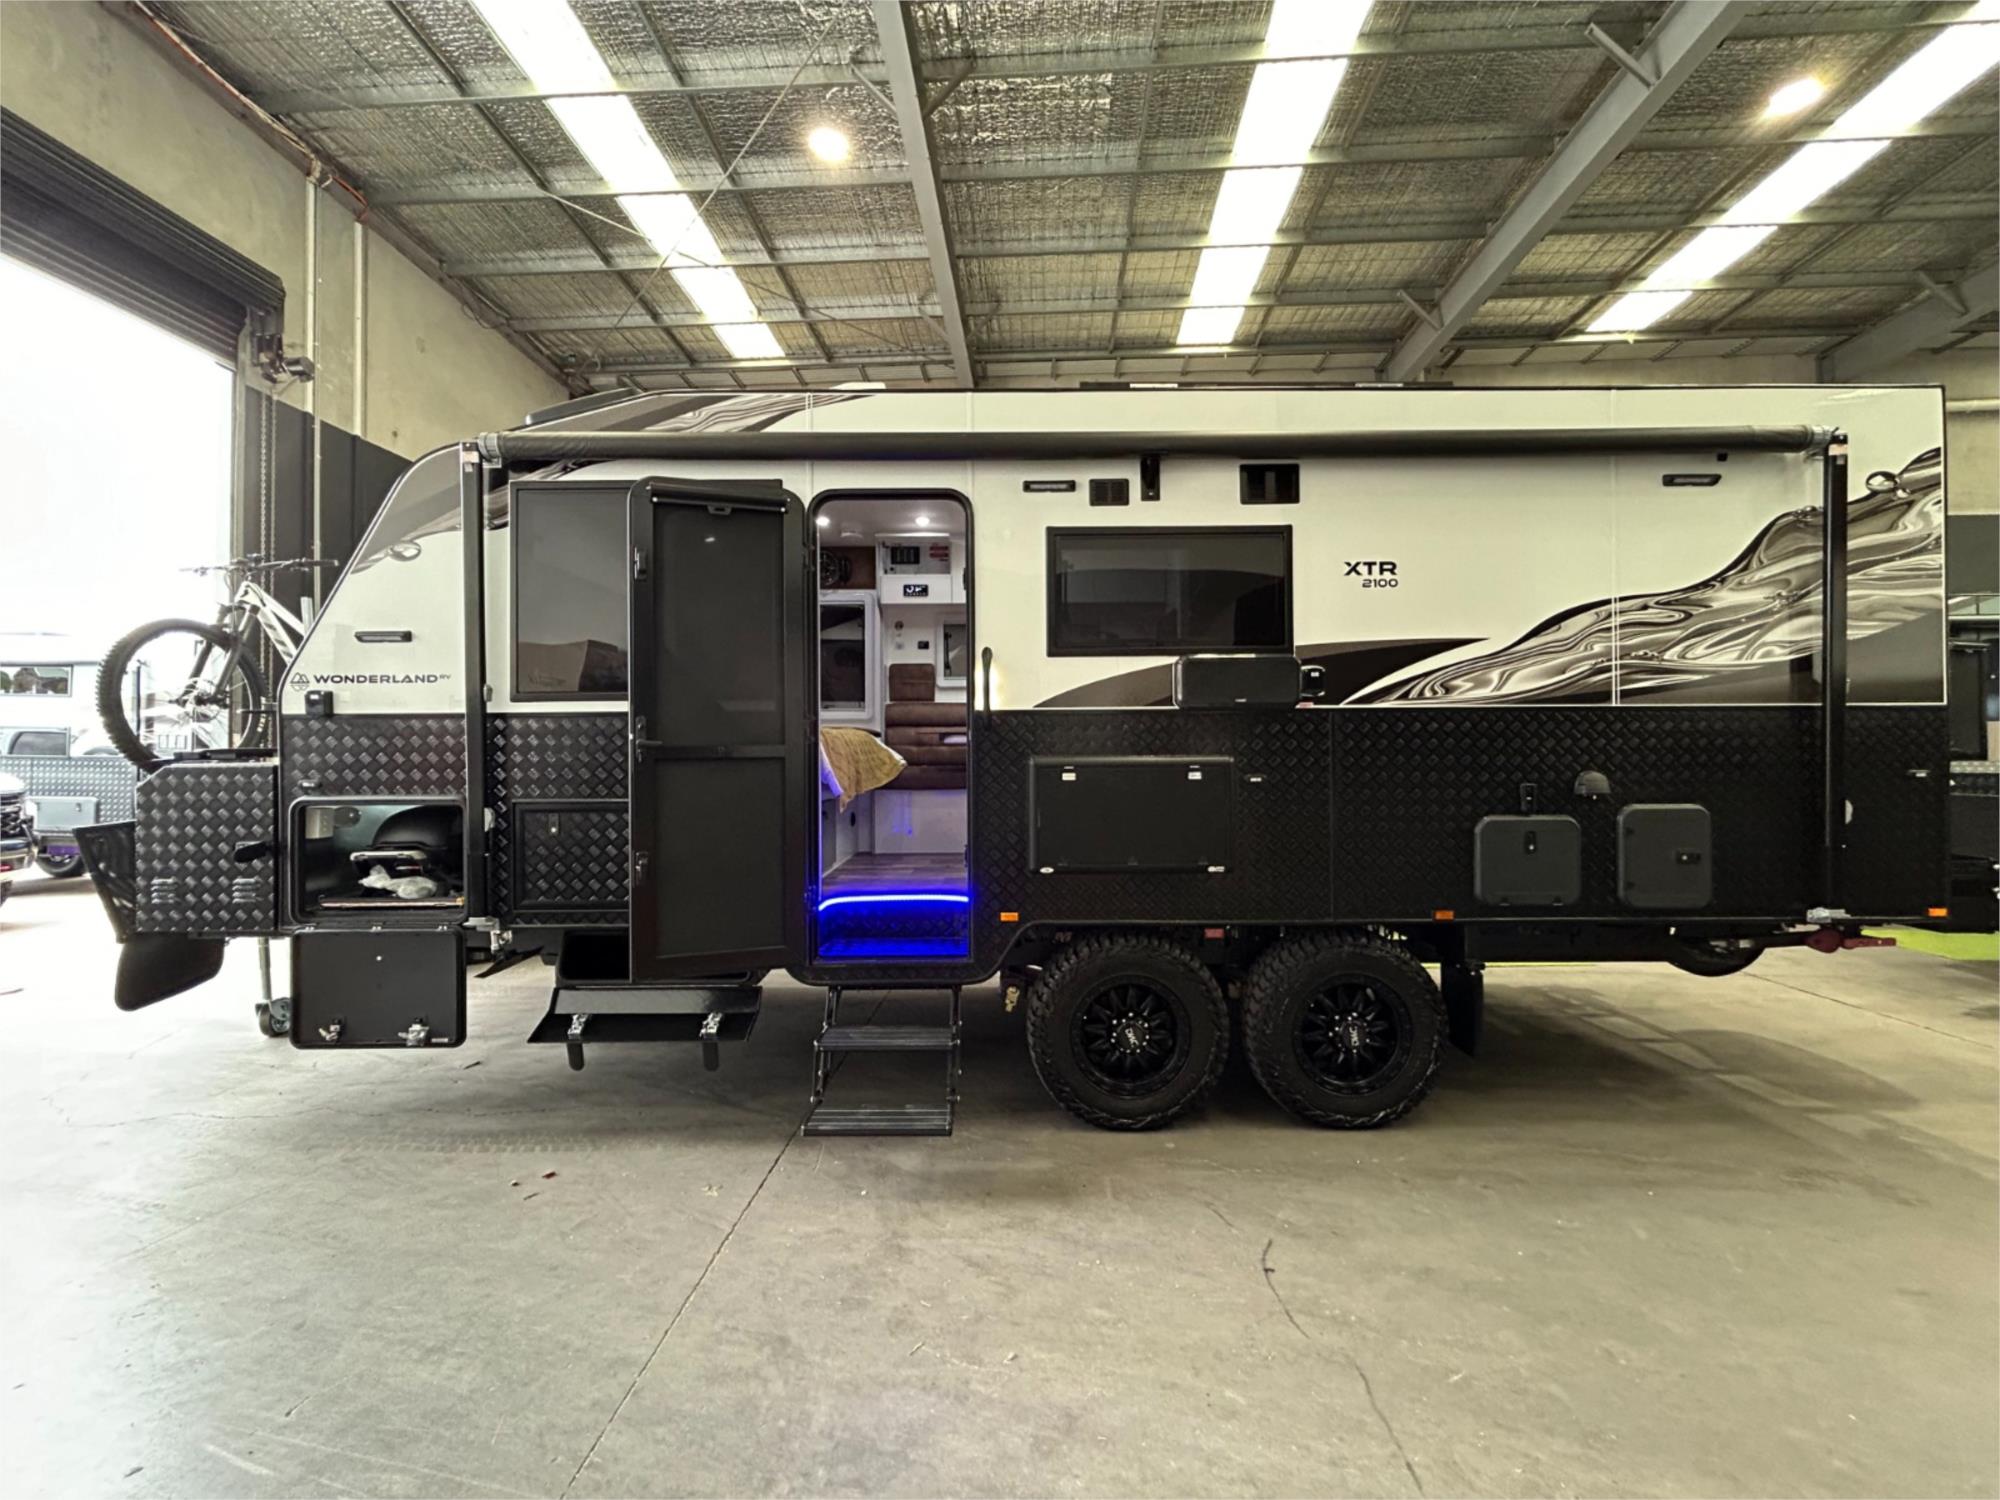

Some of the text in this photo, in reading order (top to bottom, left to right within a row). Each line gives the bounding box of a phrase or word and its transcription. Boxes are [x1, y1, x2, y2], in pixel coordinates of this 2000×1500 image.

[1343, 560, 1398, 576] XTR
[1361, 578, 1399, 589] 2100
[313, 674, 439, 684] WONDERLAND
